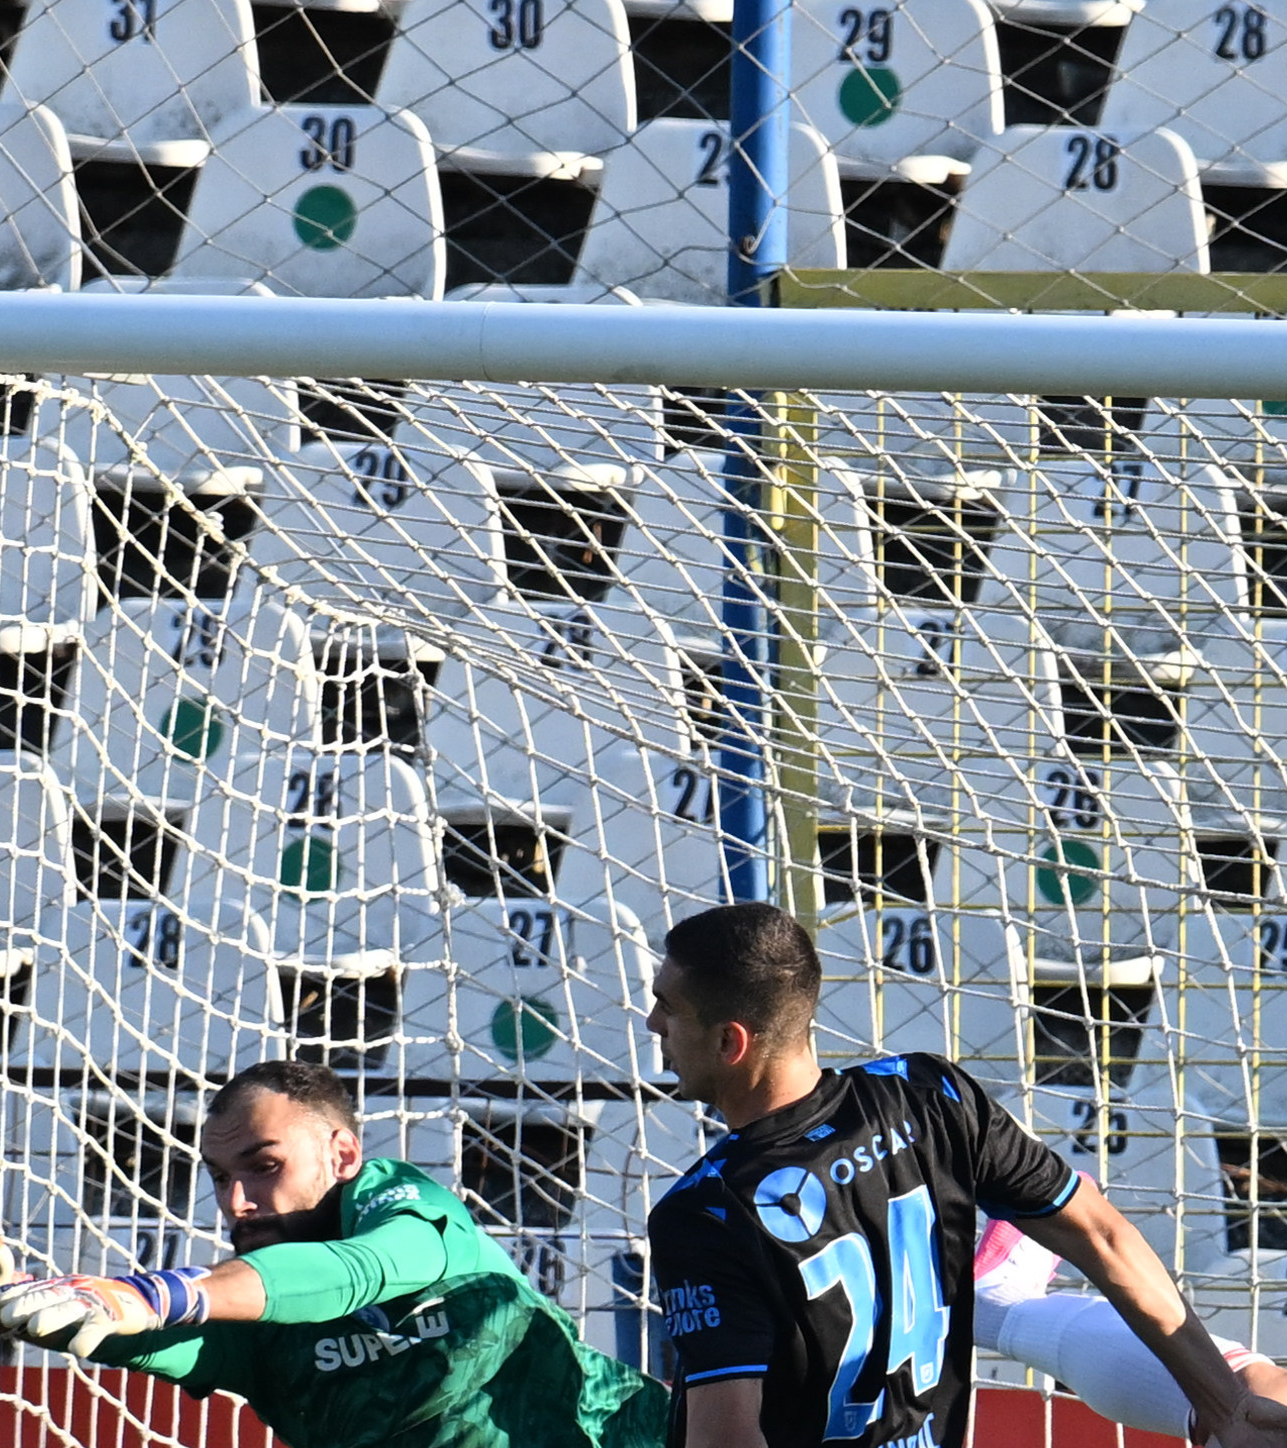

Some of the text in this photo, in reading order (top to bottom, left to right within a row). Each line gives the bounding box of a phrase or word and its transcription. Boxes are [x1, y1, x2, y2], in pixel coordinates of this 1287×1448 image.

[488, 0, 544, 50] 30
[838, 10, 892, 62] 29
[1216, 10, 1266, 60] 28
[300, 116, 354, 171] 30
[697, 133, 730, 185] 2
[1067, 136, 1118, 190] 28
[353, 451, 411, 507] 29
[171, 611, 227, 668] 29
[1047, 771, 1098, 828] 26
[126, 911, 180, 969] 28
[511, 909, 554, 967] 27
[881, 917, 934, 974] 26
[797, 1184, 951, 1442] 24
